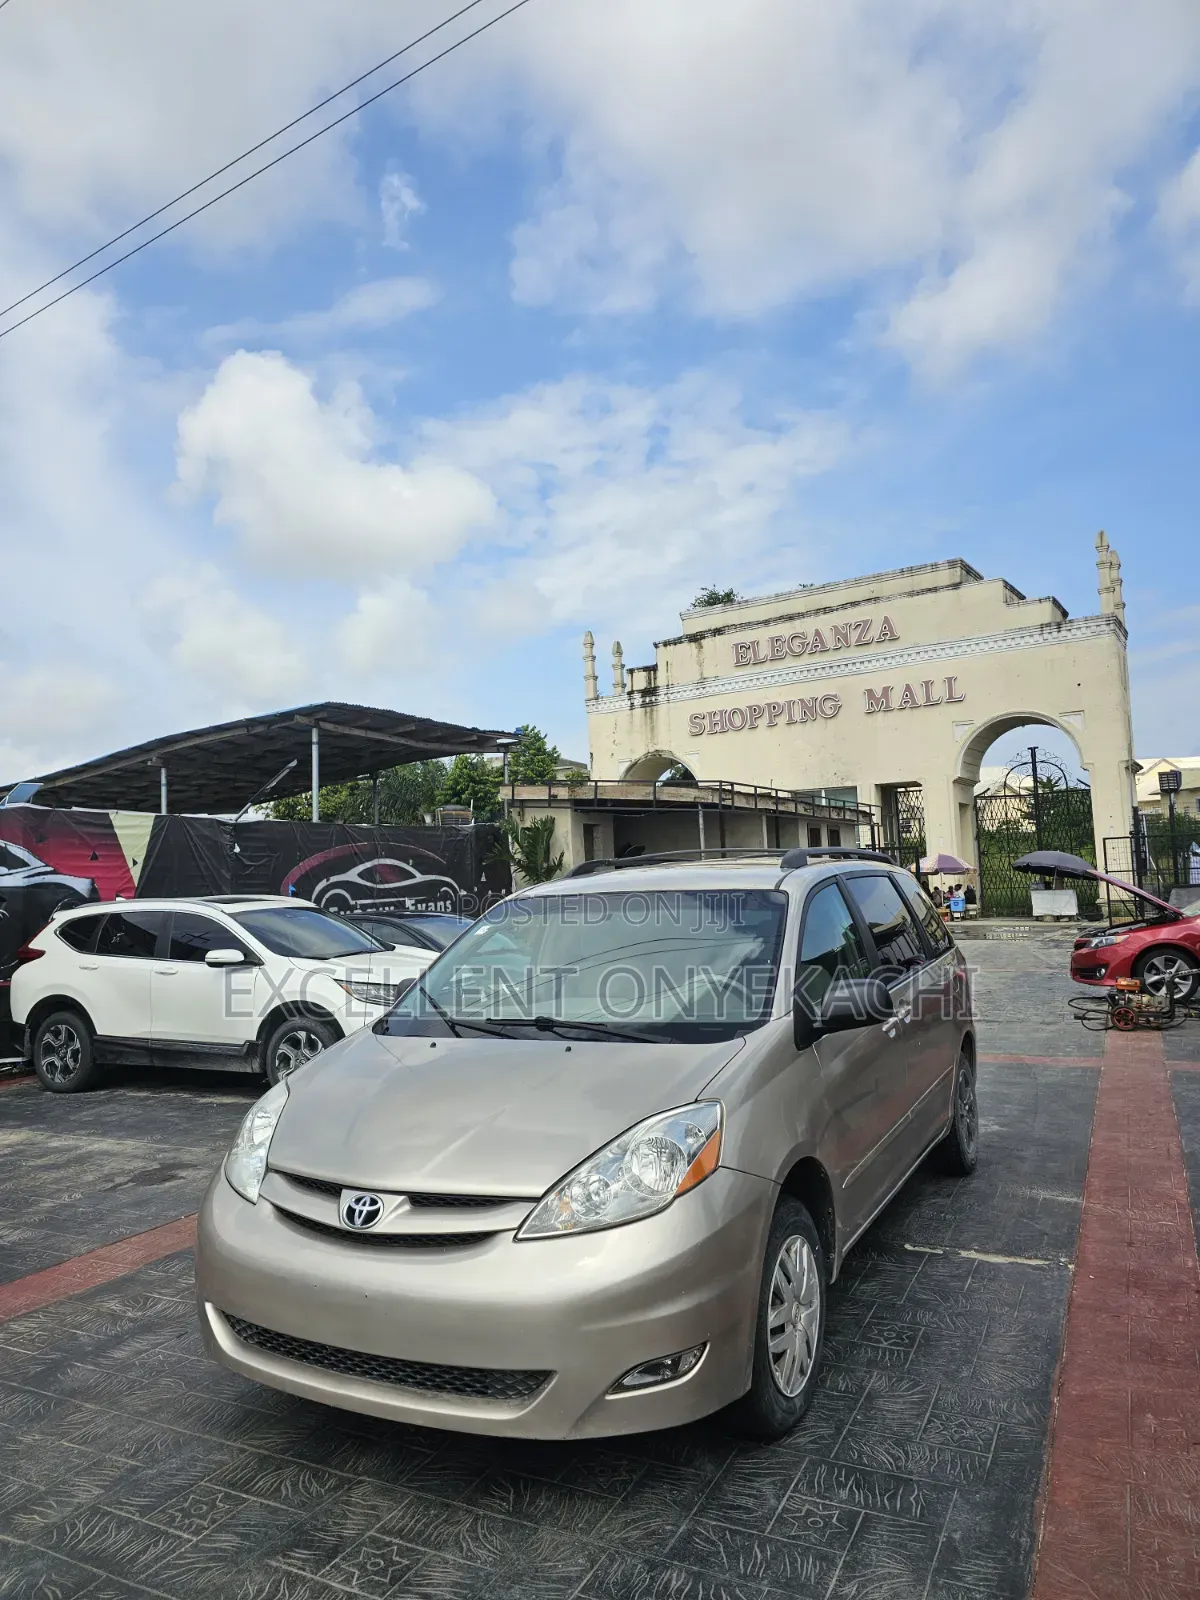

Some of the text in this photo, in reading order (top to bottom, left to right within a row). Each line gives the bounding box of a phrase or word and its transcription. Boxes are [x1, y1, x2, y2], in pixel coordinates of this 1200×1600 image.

[731, 615, 900, 667] ELEGANZA
[688, 676, 966, 736] SHOPPING MALL
